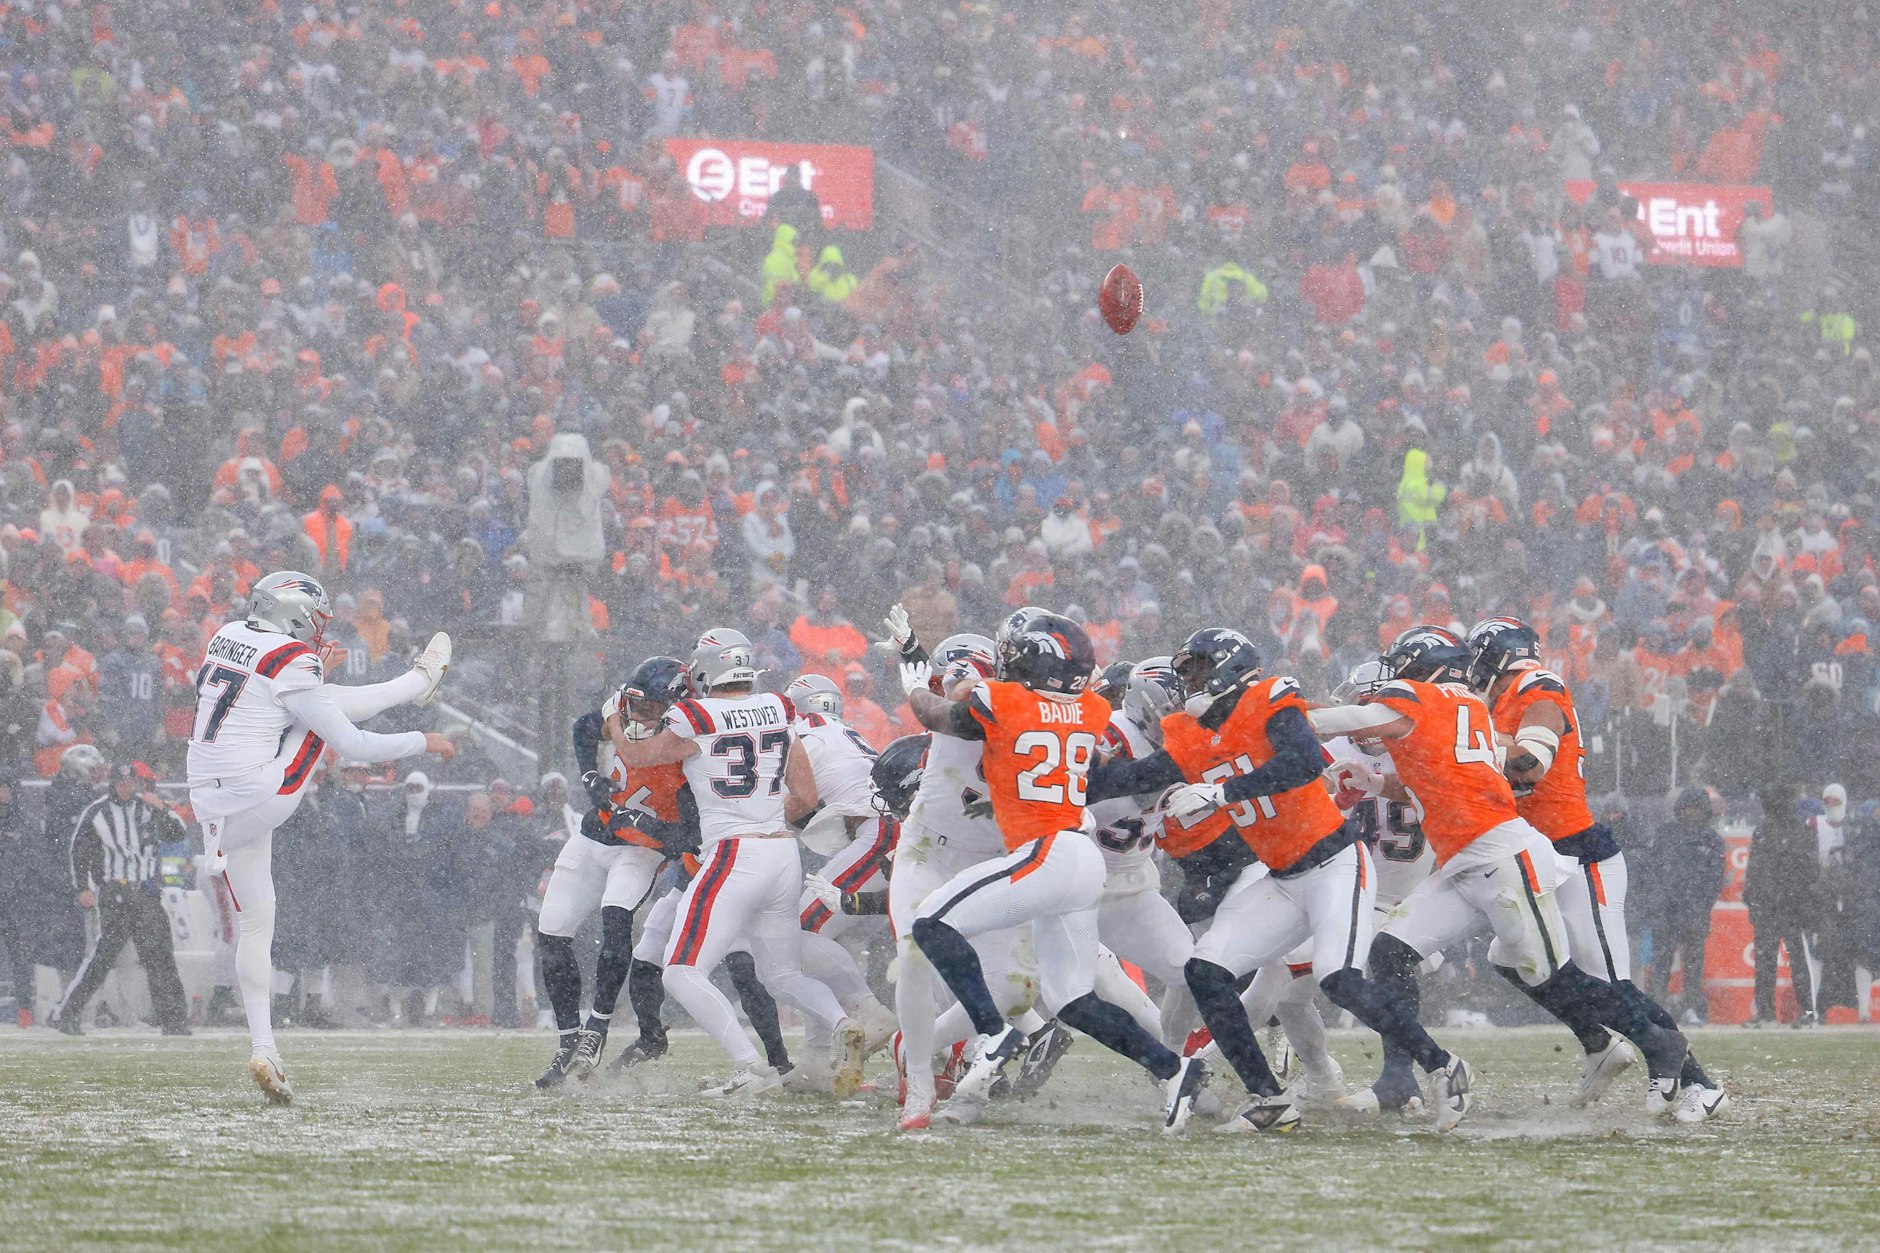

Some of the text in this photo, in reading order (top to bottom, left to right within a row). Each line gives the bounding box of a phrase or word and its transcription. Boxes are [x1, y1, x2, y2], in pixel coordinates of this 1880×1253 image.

[1650, 198, 1720, 237] Ent
[1652, 237, 1737, 256] redit Union
[208, 635, 258, 668] BARINGER
[735, 654, 751, 667] 37
[131, 672, 153, 700] 10
[1069, 675, 1088, 690] 28
[191, 660, 251, 743] 17
[823, 701, 836, 713] 91
[1037, 701, 1084, 725] BADIE
[721, 705, 780, 730] WESTOVER
[1454, 704, 1502, 776] 4
[709, 727, 792, 799] 37
[1013, 730, 1097, 808] 28
[1731, 847, 1750, 870] G
